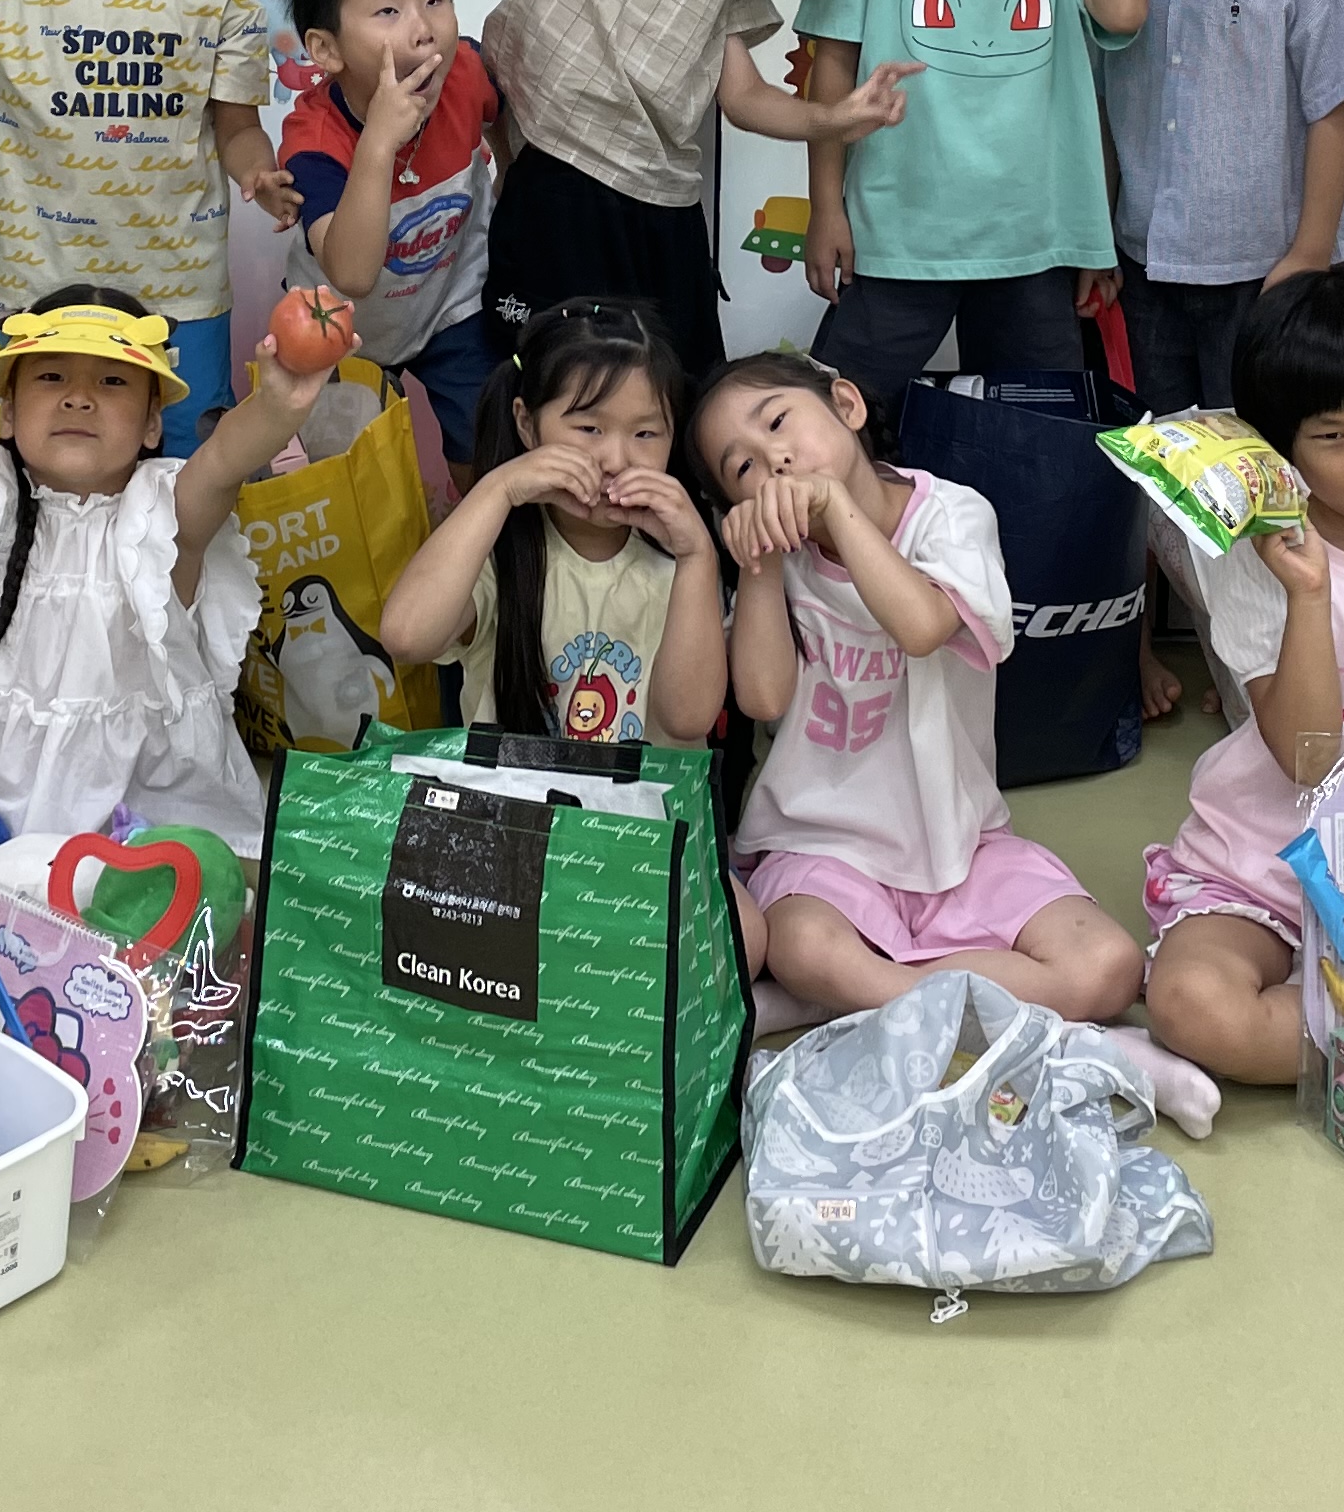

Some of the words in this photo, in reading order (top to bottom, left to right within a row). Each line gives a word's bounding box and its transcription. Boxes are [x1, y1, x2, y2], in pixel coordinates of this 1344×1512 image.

[62, 29, 182, 57] SPORT
[75, 60, 163, 86] CLUB
[50, 92, 184, 118] SAILING
[125, 131, 170, 143] Balance
[55, 212, 97, 225] Balance
[805, 681, 892, 755] 95
[287, 829, 337, 853] Beautiful
[340, 842, 359, 860] day
[582, 817, 636, 840] Beautiful
[638, 827, 660, 845] day
[284, 898, 330, 920] Beautiful
[334, 911, 352, 928] day
[577, 891, 633, 913] Beautiful
[637, 900, 658, 918] day
[397, 951, 451, 986] Clean
[459, 967, 521, 1001] Korea
[574, 963, 630, 985] Beautiful
[635, 971, 656, 990] day
[374, 989, 422, 1013] Beautiful
[426, 1004, 444, 1022] day
[321, 1013, 373, 1038] Beautiful
[376, 1026, 396, 1045] day
[468, 1015, 521, 1037] Beautiful
[524, 1027, 544, 1045] day
[318, 1052, 338, 1071] day
[421, 1036, 474, 1059] Beautiful
[475, 1049, 495, 1066] day
[572, 1035, 629, 1056] Beautiful
[631, 1045, 653, 1063] day
[363, 1061, 417, 1085] Beautiful
[419, 1074, 440, 1092] day
[309, 1088, 362, 1110] Beautiful
[365, 1099, 385, 1118] day
[465, 1083, 517, 1107] Beautiful
[520, 1096, 541, 1115] day
[411, 1108, 462, 1132] Beautiful
[467, 1121, 486, 1140] day
[567, 1105, 624, 1128] Beautiful
[627, 1117, 648, 1135] day
[357, 1134, 409, 1157] Beautiful
[413, 1146, 433, 1165] day
[513, 1131, 569, 1153] Beautiful
[572, 1142, 592, 1160] day
[303, 1160, 355, 1182] Beautiful
[358, 1172, 378, 1190] day
[459, 1156, 512, 1181] Beautiful
[516, 1169, 537, 1187] day
[405, 1181, 459, 1205] Beautiful
[462, 1194, 482, 1212] day
[564, 1177, 619, 1200] Beautiful
[624, 1188, 645, 1207] day
[509, 1204, 566, 1226] Beautiful
[567, 1215, 589, 1233] day
